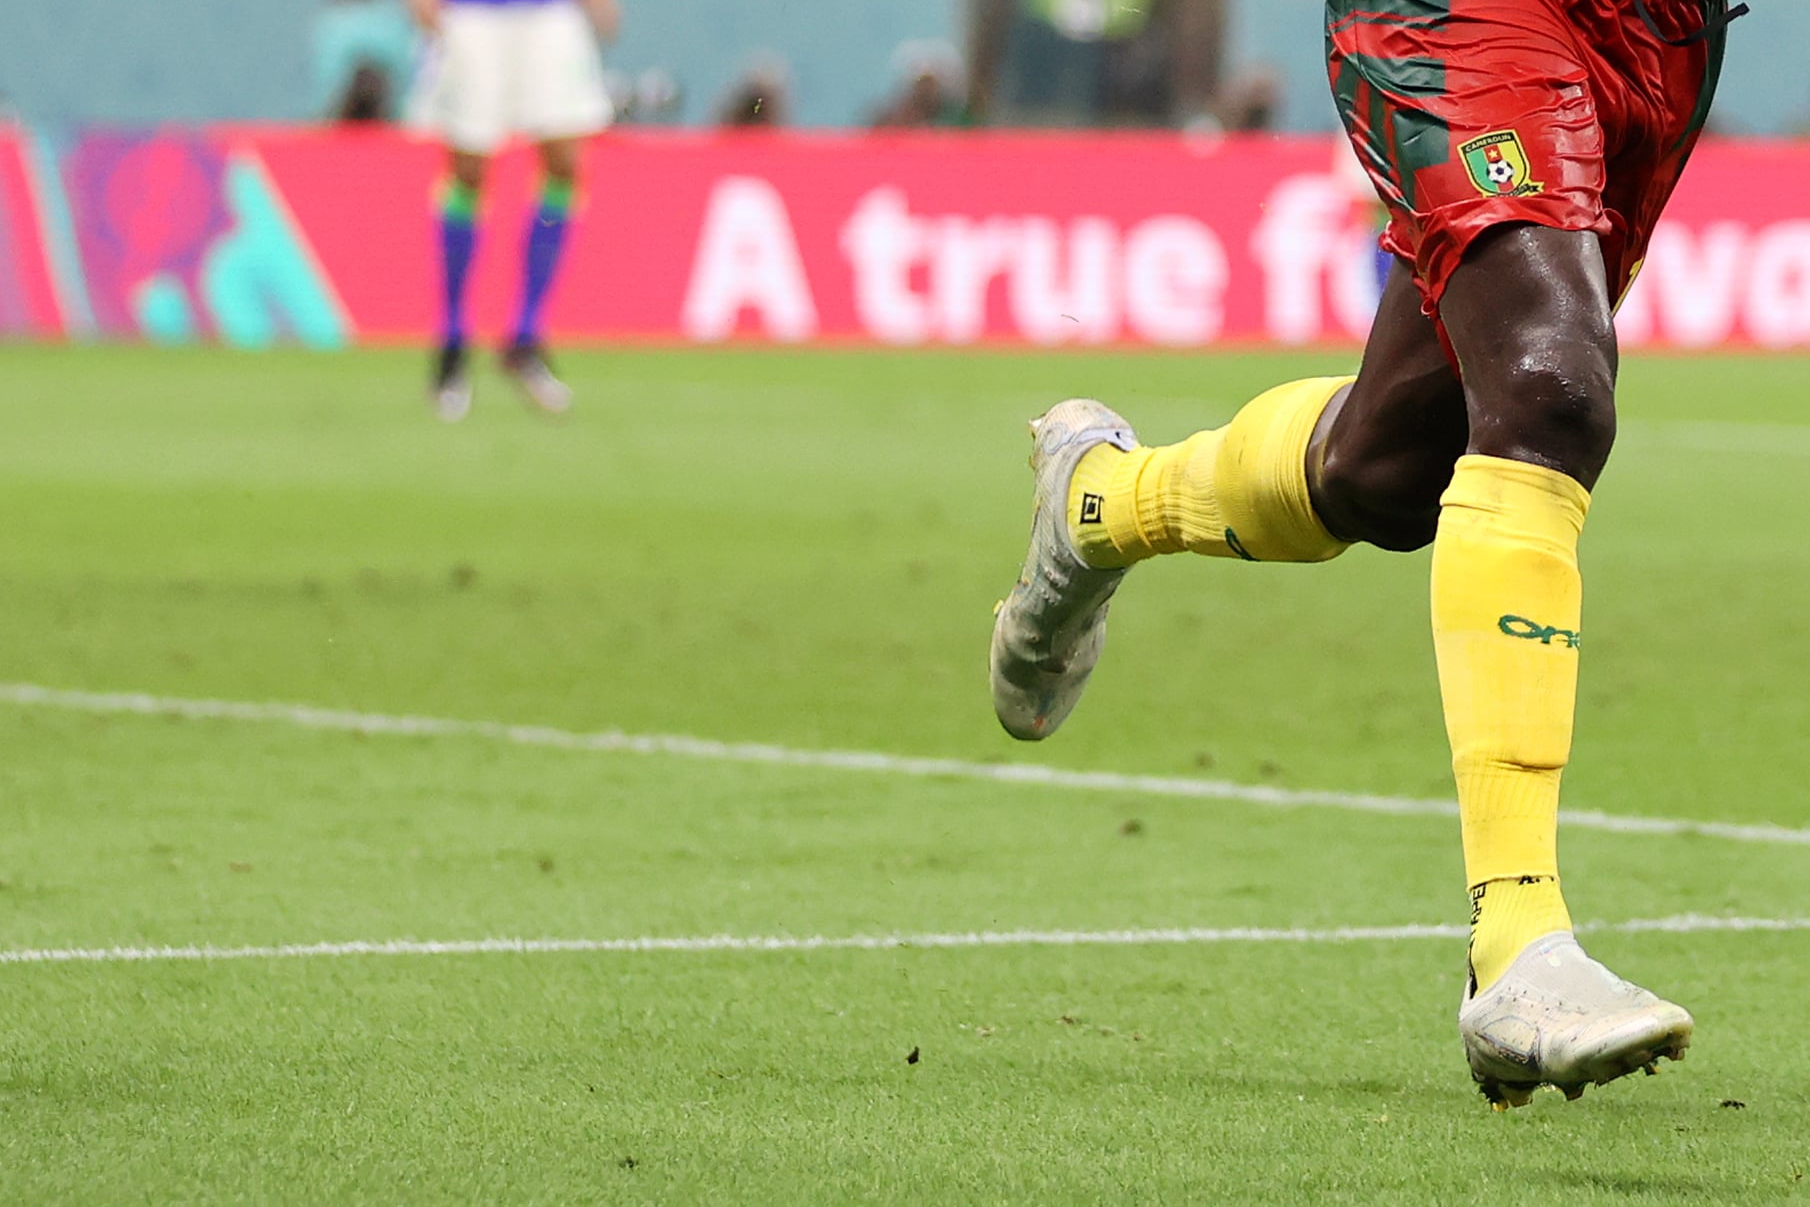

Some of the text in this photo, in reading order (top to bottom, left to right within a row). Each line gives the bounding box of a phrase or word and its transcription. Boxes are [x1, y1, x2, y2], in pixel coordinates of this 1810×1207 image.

[1464, 134, 1512, 152] CAMEROUN
[680, 173, 820, 344] A
[840, 184, 1231, 346] true
